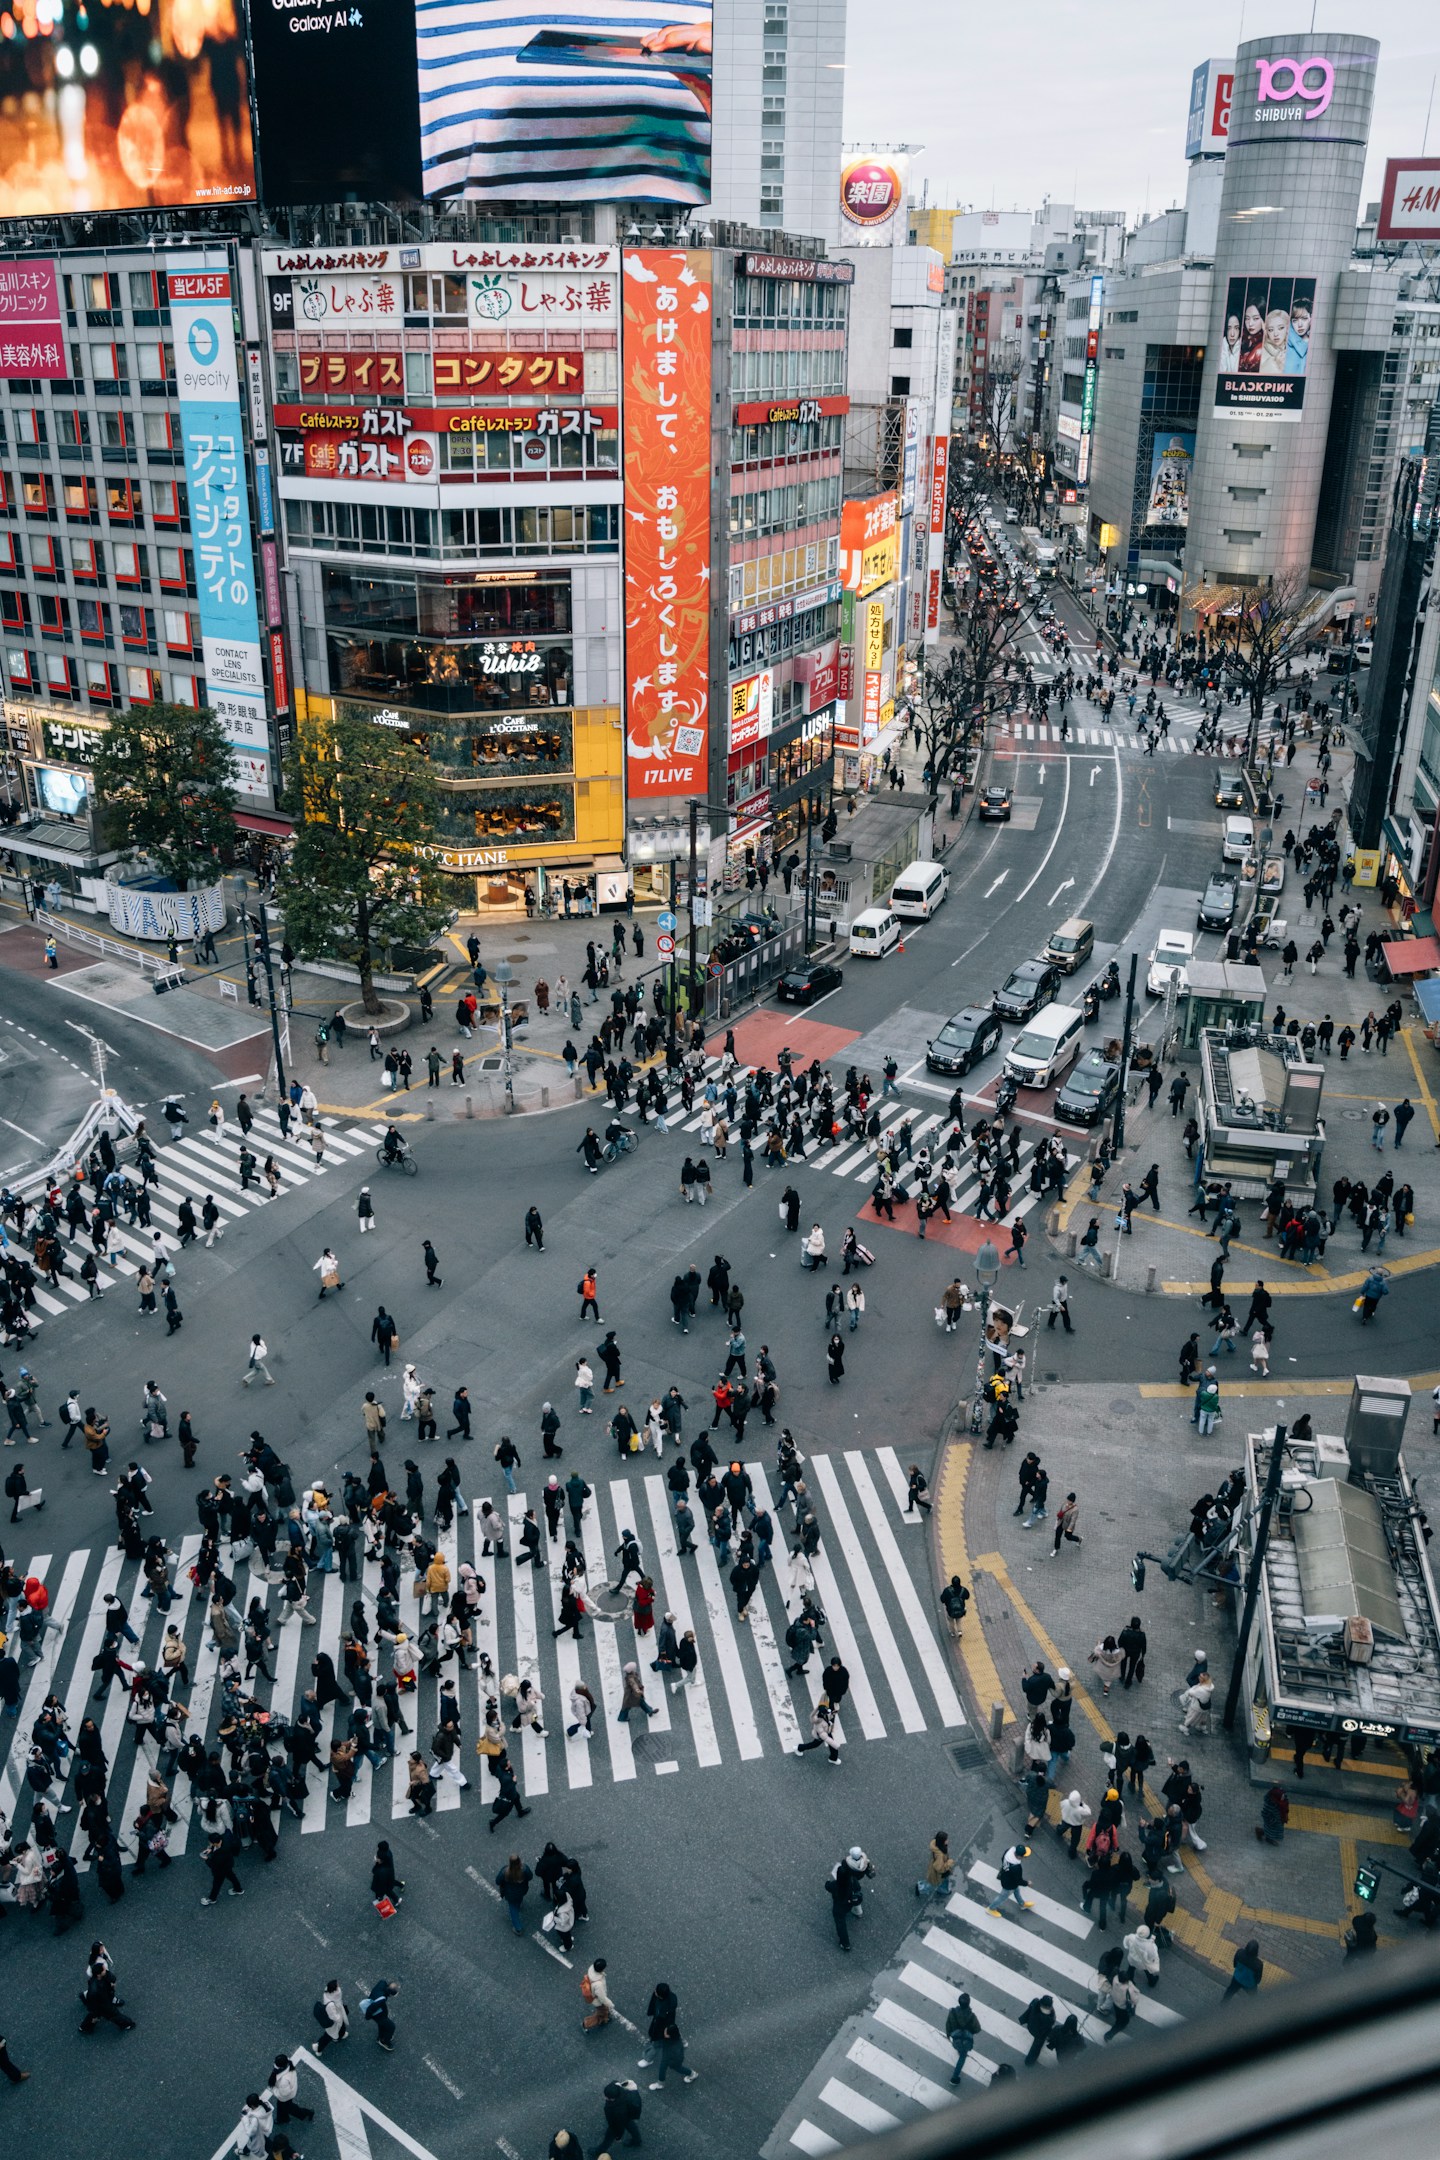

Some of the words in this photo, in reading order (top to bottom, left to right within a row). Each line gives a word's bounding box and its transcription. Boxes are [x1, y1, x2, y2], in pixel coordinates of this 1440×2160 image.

[289, 15, 333, 33] Galaxy
[334, 10, 347, 27] AI
[1256, 57, 1335, 120] 109
[1255, 107, 1302, 122] SHIBUYA
[195, 184, 251, 197] www.hit-ad.co.jp
[847, 180, 893, 204] 楽園
[1401, 185, 1440, 213] H&M
[277, 250, 389, 272] しゃぶしゃぶバイキング
[401, 251, 418, 266] 寿司
[452, 249, 611, 269] しゃぶしゃぶバイキング
[754, 256, 816, 277] しゃぶしゃぶバイキング
[980, 251, 1029, 261] 井門ビル
[174, 277, 223, 297] 当ビル5F
[521, 280, 612, 313] しゃぶ葉
[0, 293, 47, 312] クリニック
[273, 293, 292, 312] 9F
[331, 283, 395, 314] しゃぶ葉
[0, 343, 60, 368] 美容外科
[184, 370, 230, 390] eyecity
[301, 357, 402, 386] プライス
[435, 358, 579, 386] コンタクト
[655, 285, 679, 455] あけまして、
[1224, 380, 1294, 393] BLACKPINK
[251, 371, 264, 430] 献血ルーム
[1238, 394, 1285, 403] SHIBUYA109
[300, 411, 360, 429] Caféレストラン
[361, 408, 412, 436] ガスト
[799, 400, 822, 424] ガスト
[449, 414, 532, 431] Caféレストラン
[536, 409, 602, 437] ガスト
[281, 443, 304, 463] 7F
[309, 443, 335, 459] Café
[338, 442, 399, 476] ガスト
[411, 455, 432, 466] ガスト
[311, 460, 335, 470] レストラン
[932, 474, 945, 524] TaxFree
[189, 434, 226, 603] アイシティ
[218, 435, 249, 605] コンタクトの
[830, 582, 842, 600] 4F
[657, 485, 680, 728] おもしろくします。
[271, 617, 280, 626] 4F
[869, 605, 882, 668] 処方せん3F
[215, 648, 248, 659] CONTACT
[729, 631, 764, 665] AGA
[211, 668, 257, 682] SPECIALISTS
[223, 660, 242, 669] LENS
[479, 655, 541, 674] Ushi8
[815, 667, 834, 690] アコム
[734, 687, 746, 716] 薬
[866, 675, 879, 721] スギ薬局
[217, 702, 257, 719] 隐形眼镜
[224, 718, 254, 735] 专卖店
[373, 715, 410, 729] L'OCCITANE
[490, 723, 538, 734] L'OCCITANE
[802, 711, 830, 743] LUSH
[732, 721, 759, 745] サンドラッグ
[644, 768, 693, 784] 17LIVE
[1360, 1721, 1395, 1734] しぶちか
